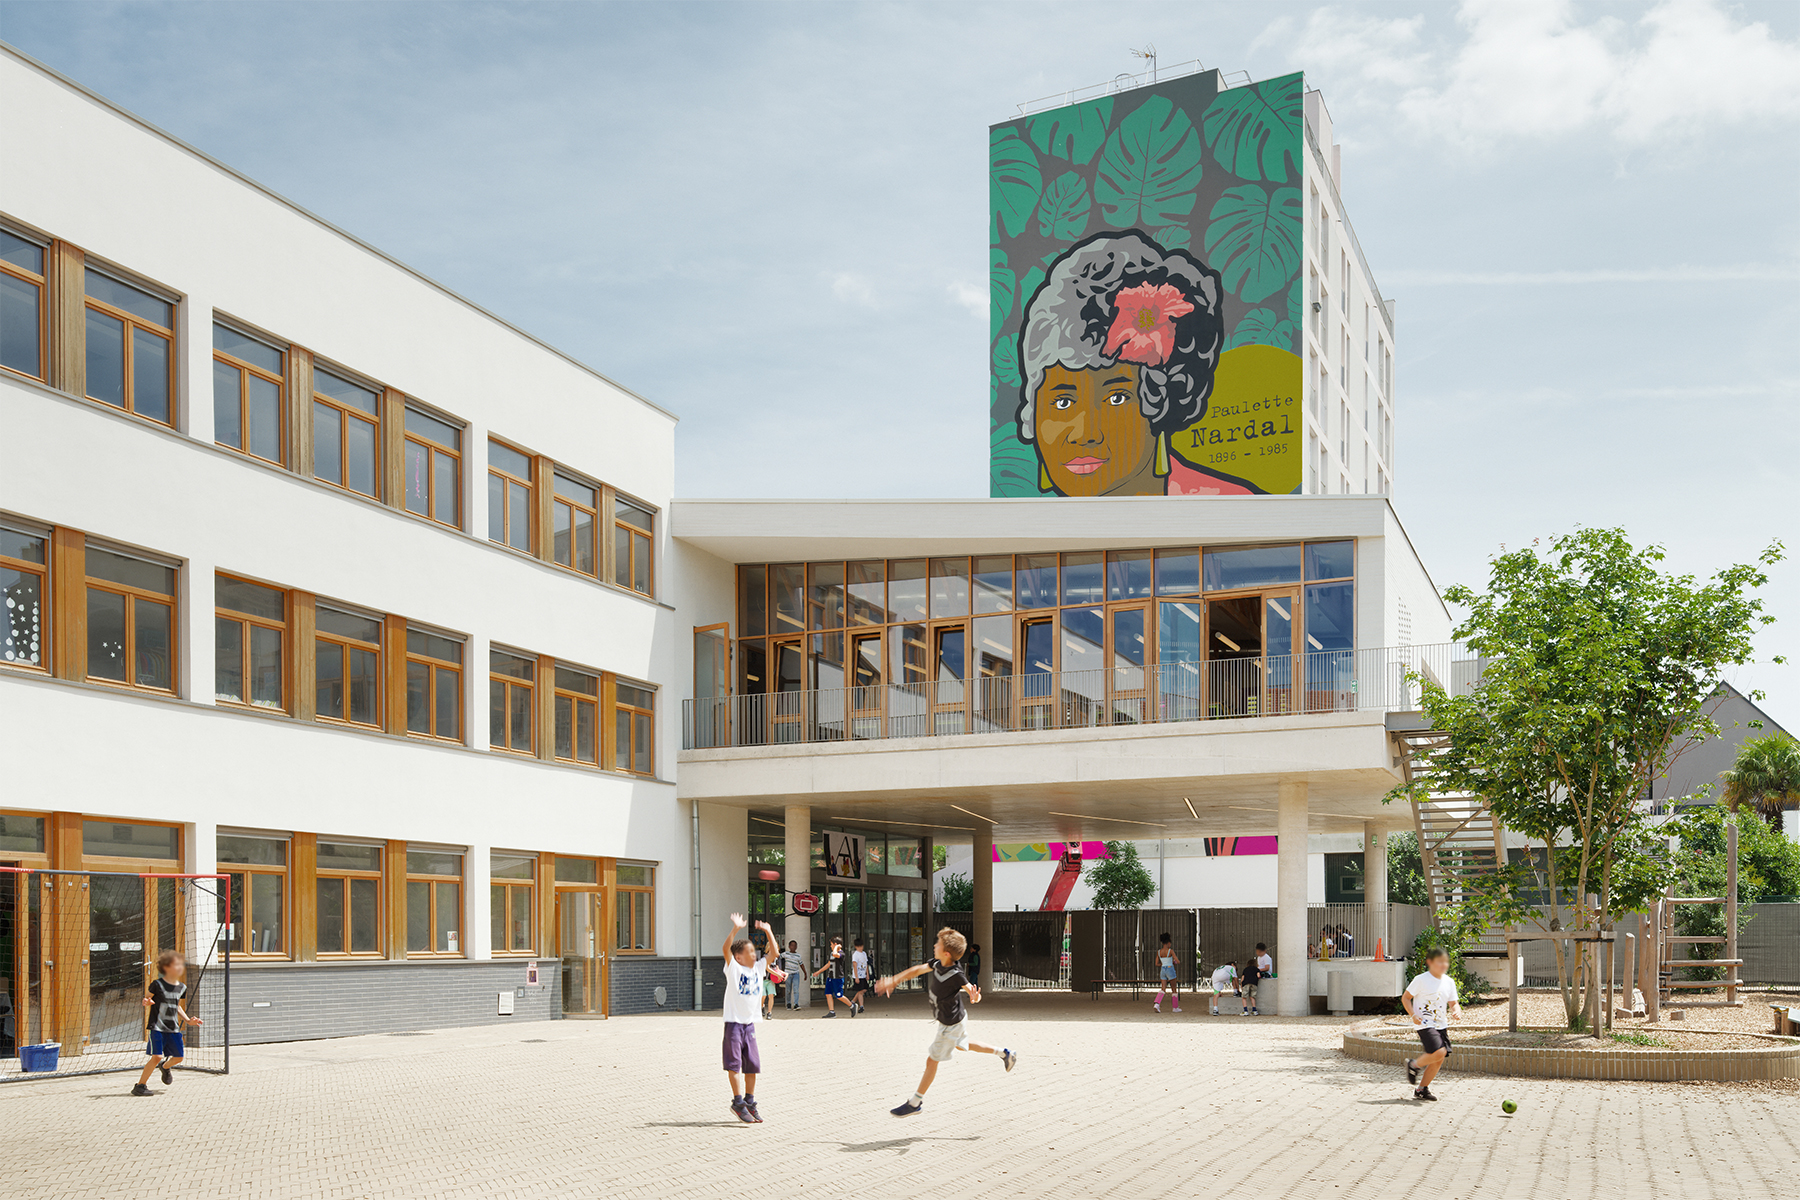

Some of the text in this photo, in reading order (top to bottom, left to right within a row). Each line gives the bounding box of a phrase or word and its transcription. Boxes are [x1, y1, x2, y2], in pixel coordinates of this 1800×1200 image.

[1211, 395, 1293, 418] Paulette
[1190, 414, 1294, 448] Nardal
[1209, 451, 1236, 463] 1896
[1259, 443, 1288, 456] 1985
